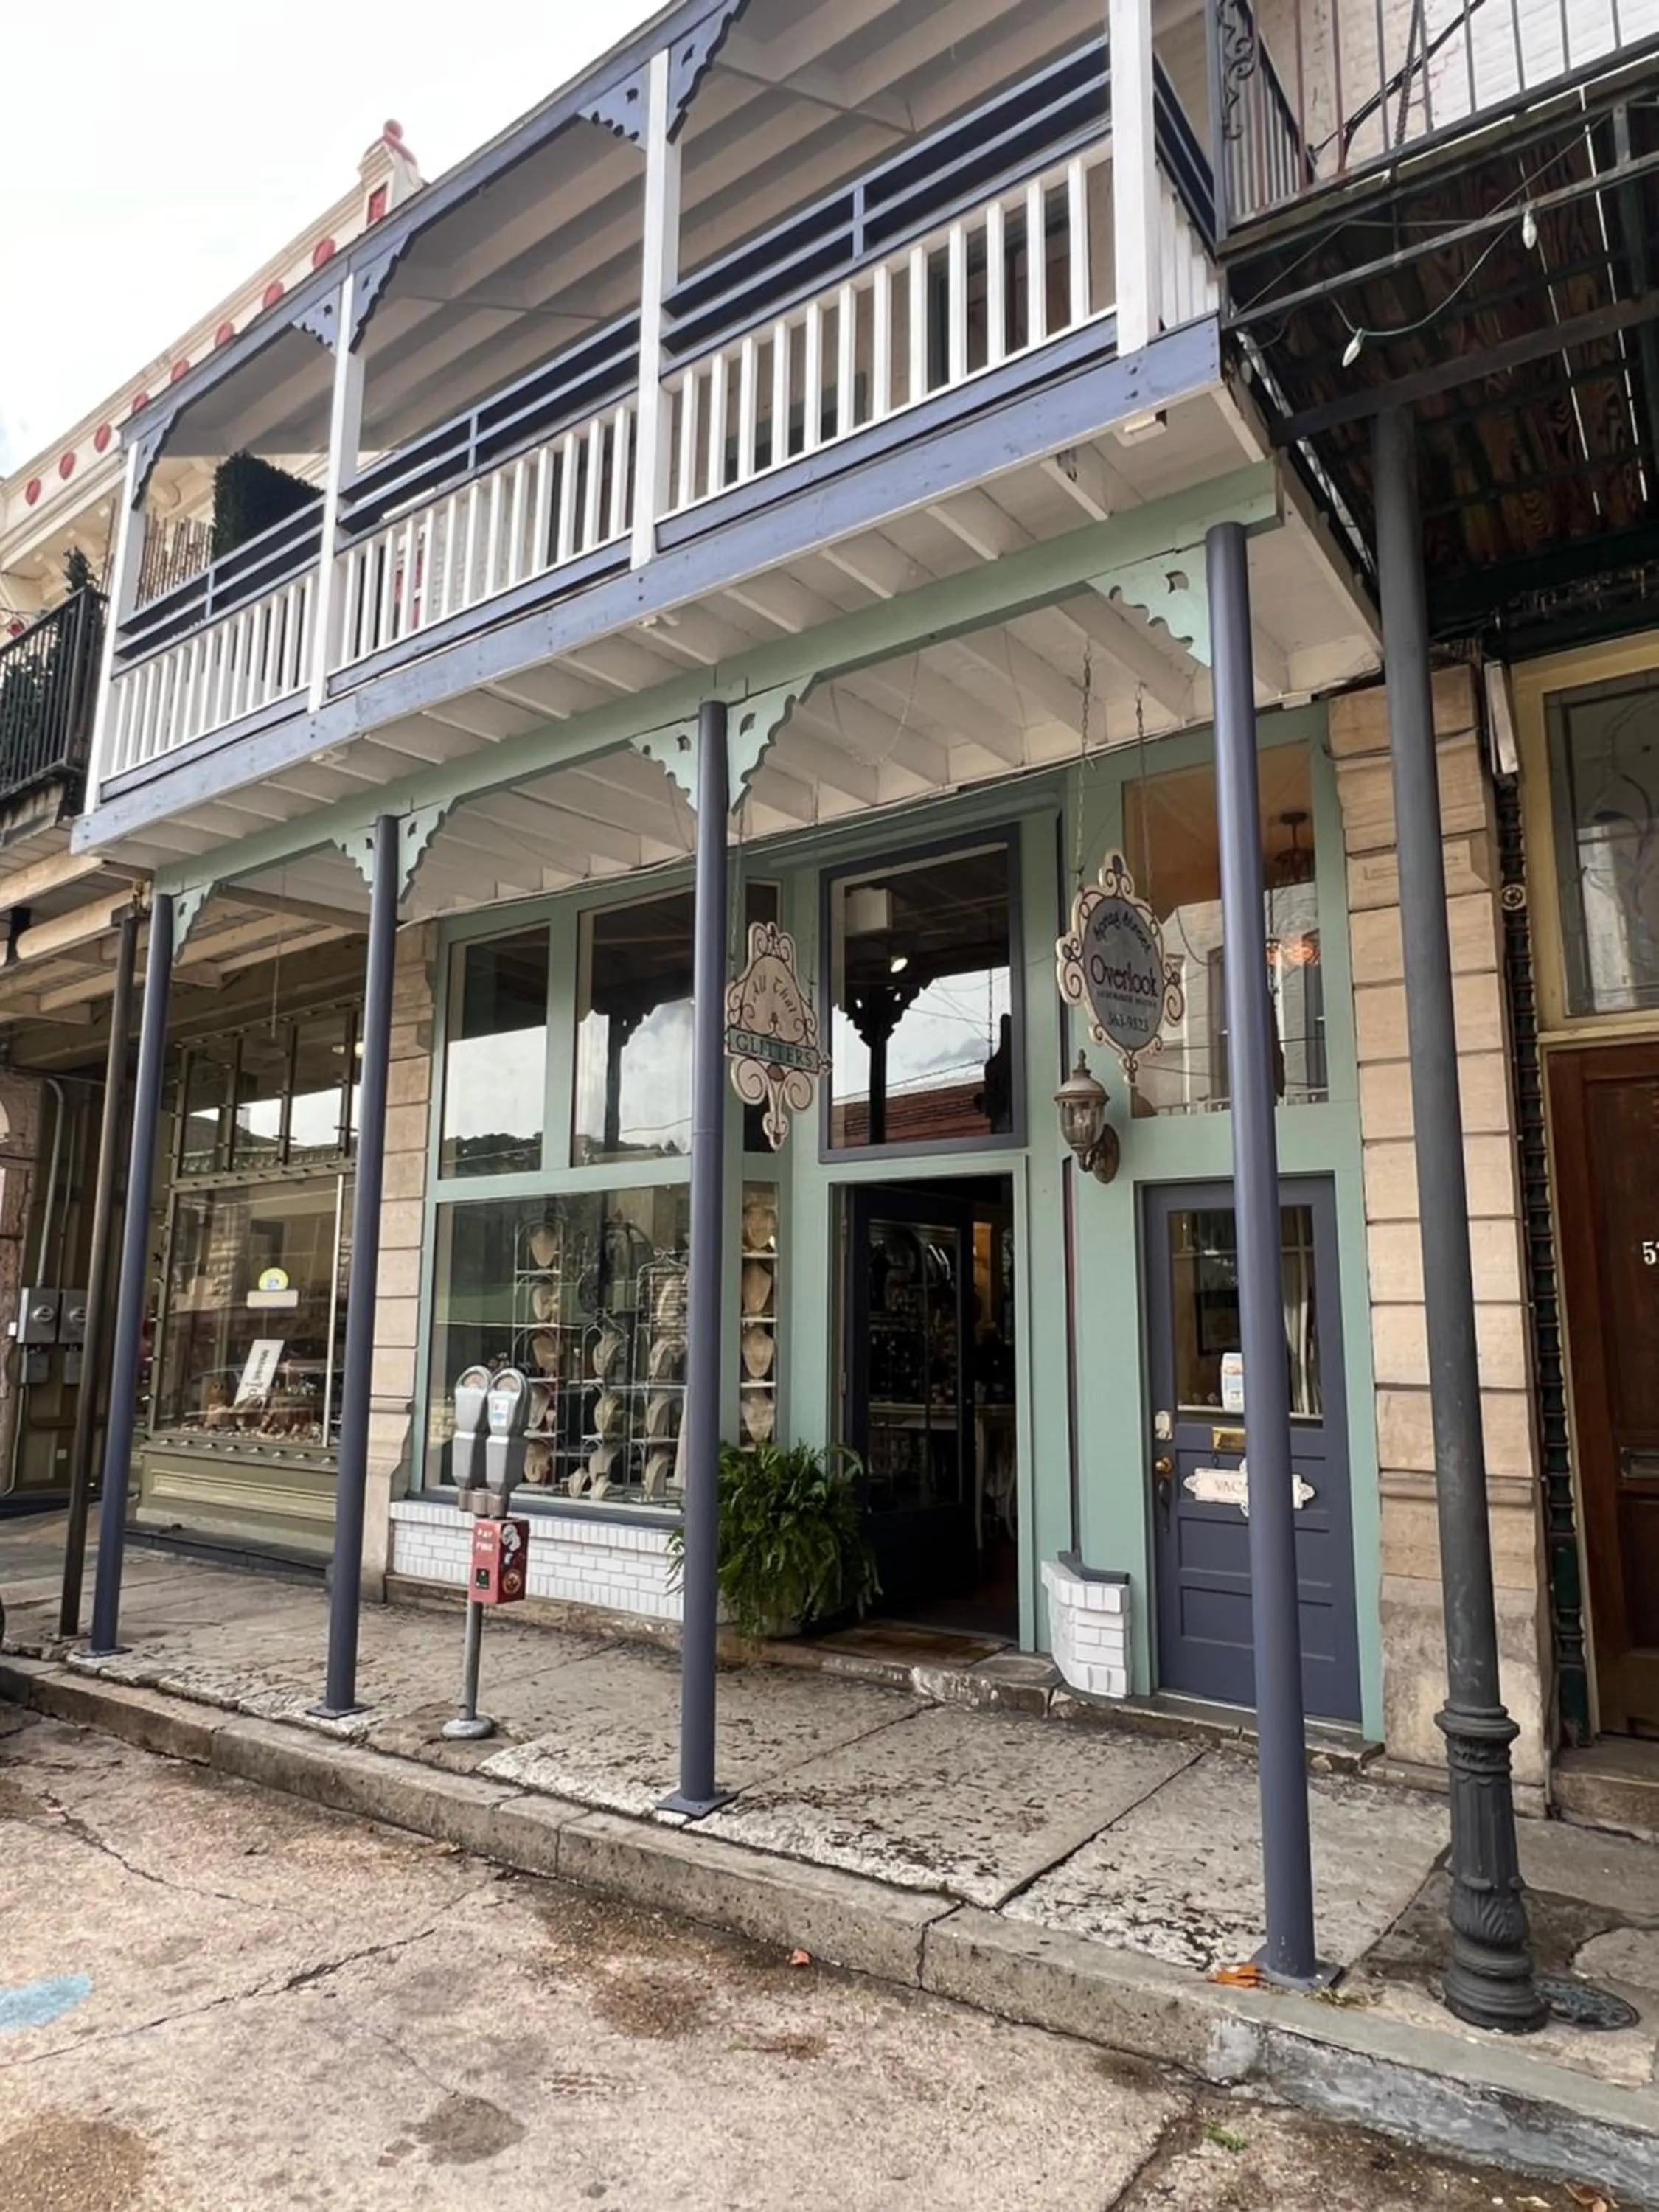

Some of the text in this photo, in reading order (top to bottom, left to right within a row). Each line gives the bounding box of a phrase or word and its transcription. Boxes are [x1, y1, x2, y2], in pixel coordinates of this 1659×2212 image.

[1091, 954, 1159, 998] Overlook
[736, 1034, 813, 1068] GLITTERS
[1641, 1240, 1659, 1265] 5
